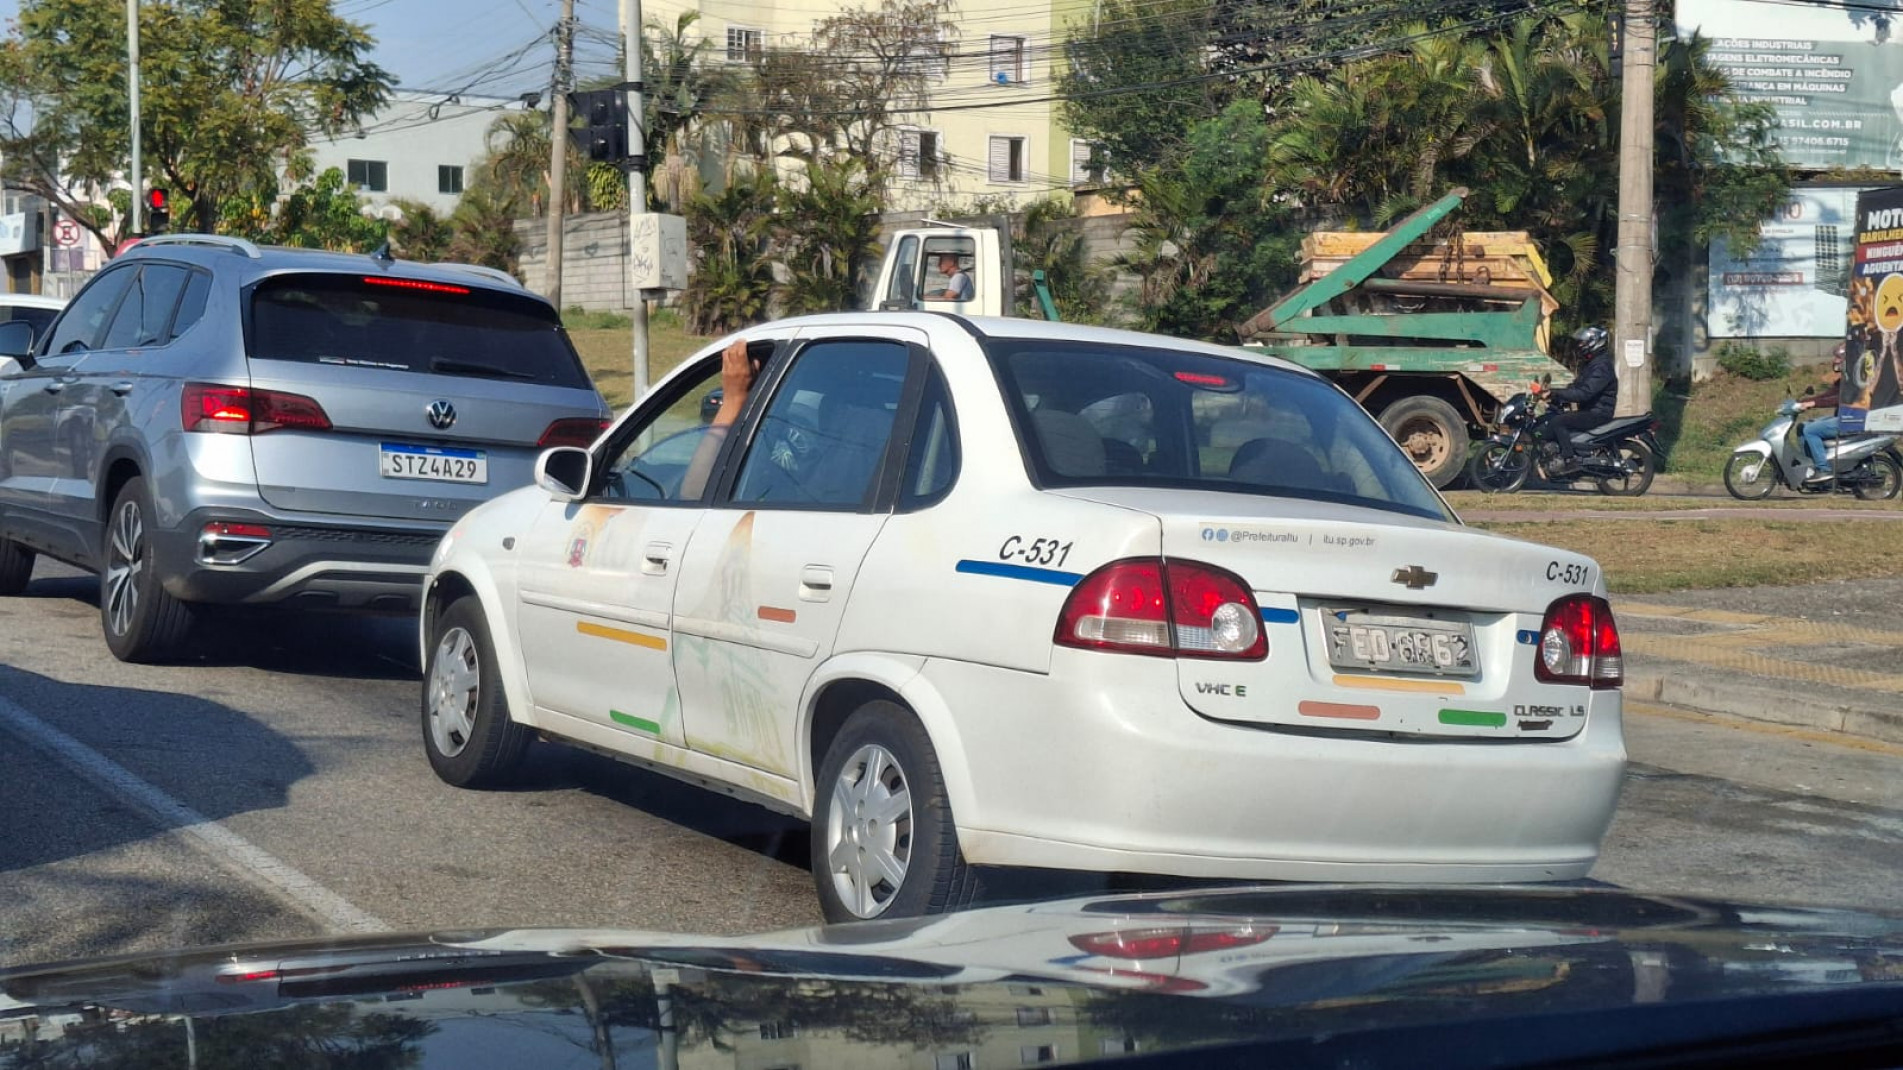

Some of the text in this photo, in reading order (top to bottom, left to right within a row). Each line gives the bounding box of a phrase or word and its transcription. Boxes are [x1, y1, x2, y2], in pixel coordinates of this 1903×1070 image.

[1752, 39, 1812, 50] INDUSTRIAIS
[1745, 53, 1840, 64] ELETROMECÂNICAS
[1732, 67, 1746, 76] DE
[1746, 67, 1794, 77] COMBATE
[1794, 68, 1803, 77] A
[1804, 67, 1852, 78] INCÊNDIO
[1777, 82, 1792, 91] EM
[1793, 82, 1846, 93] MÁQUINAS
[392, 454, 477, 479] STZ4A29
[999, 535, 1074, 568] C-531
[1546, 561, 1589, 586] C-531
[1195, 681, 1247, 698] VHC E
[1513, 704, 1565, 718] CLASSIC
